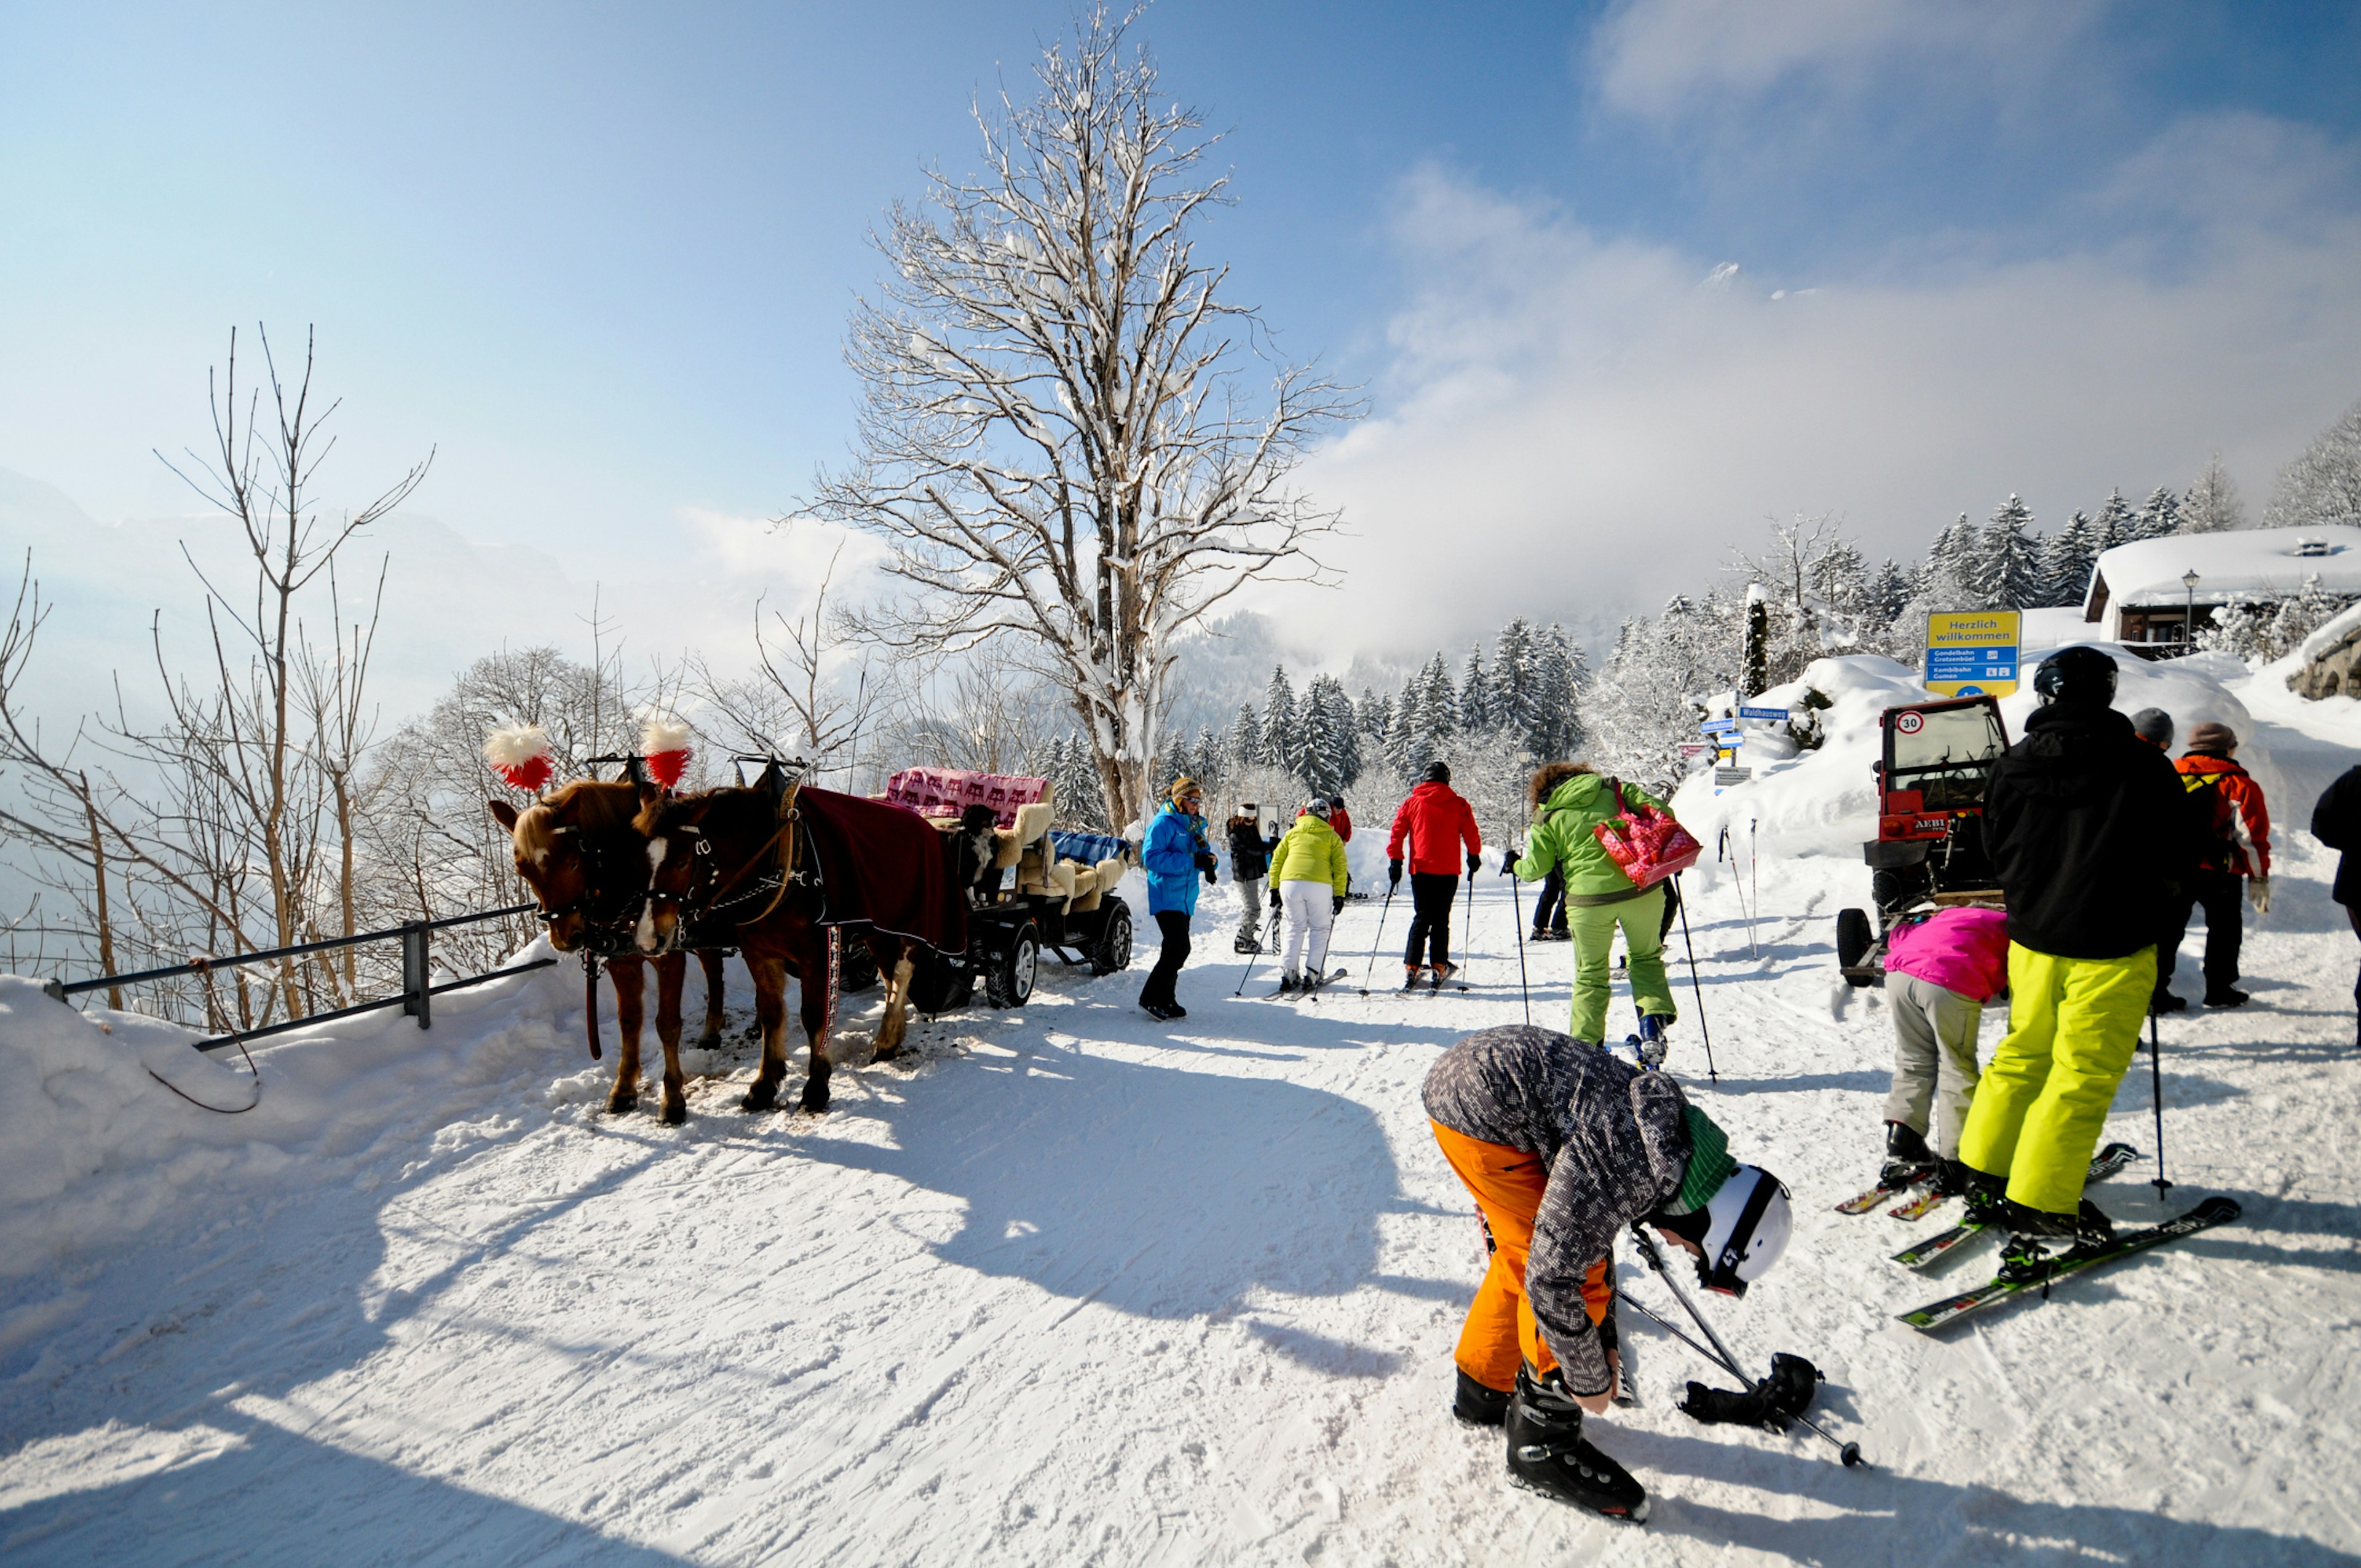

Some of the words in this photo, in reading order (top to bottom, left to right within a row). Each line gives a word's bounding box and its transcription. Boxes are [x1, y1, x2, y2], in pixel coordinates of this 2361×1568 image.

[1950, 620, 1997, 629] Herzlich
[1936, 632, 2010, 641] willkommen
[1742, 708, 1786, 719] Waldhausweg
[1904, 719, 1917, 728] 30
[1915, 818, 1945, 829] AEBI
